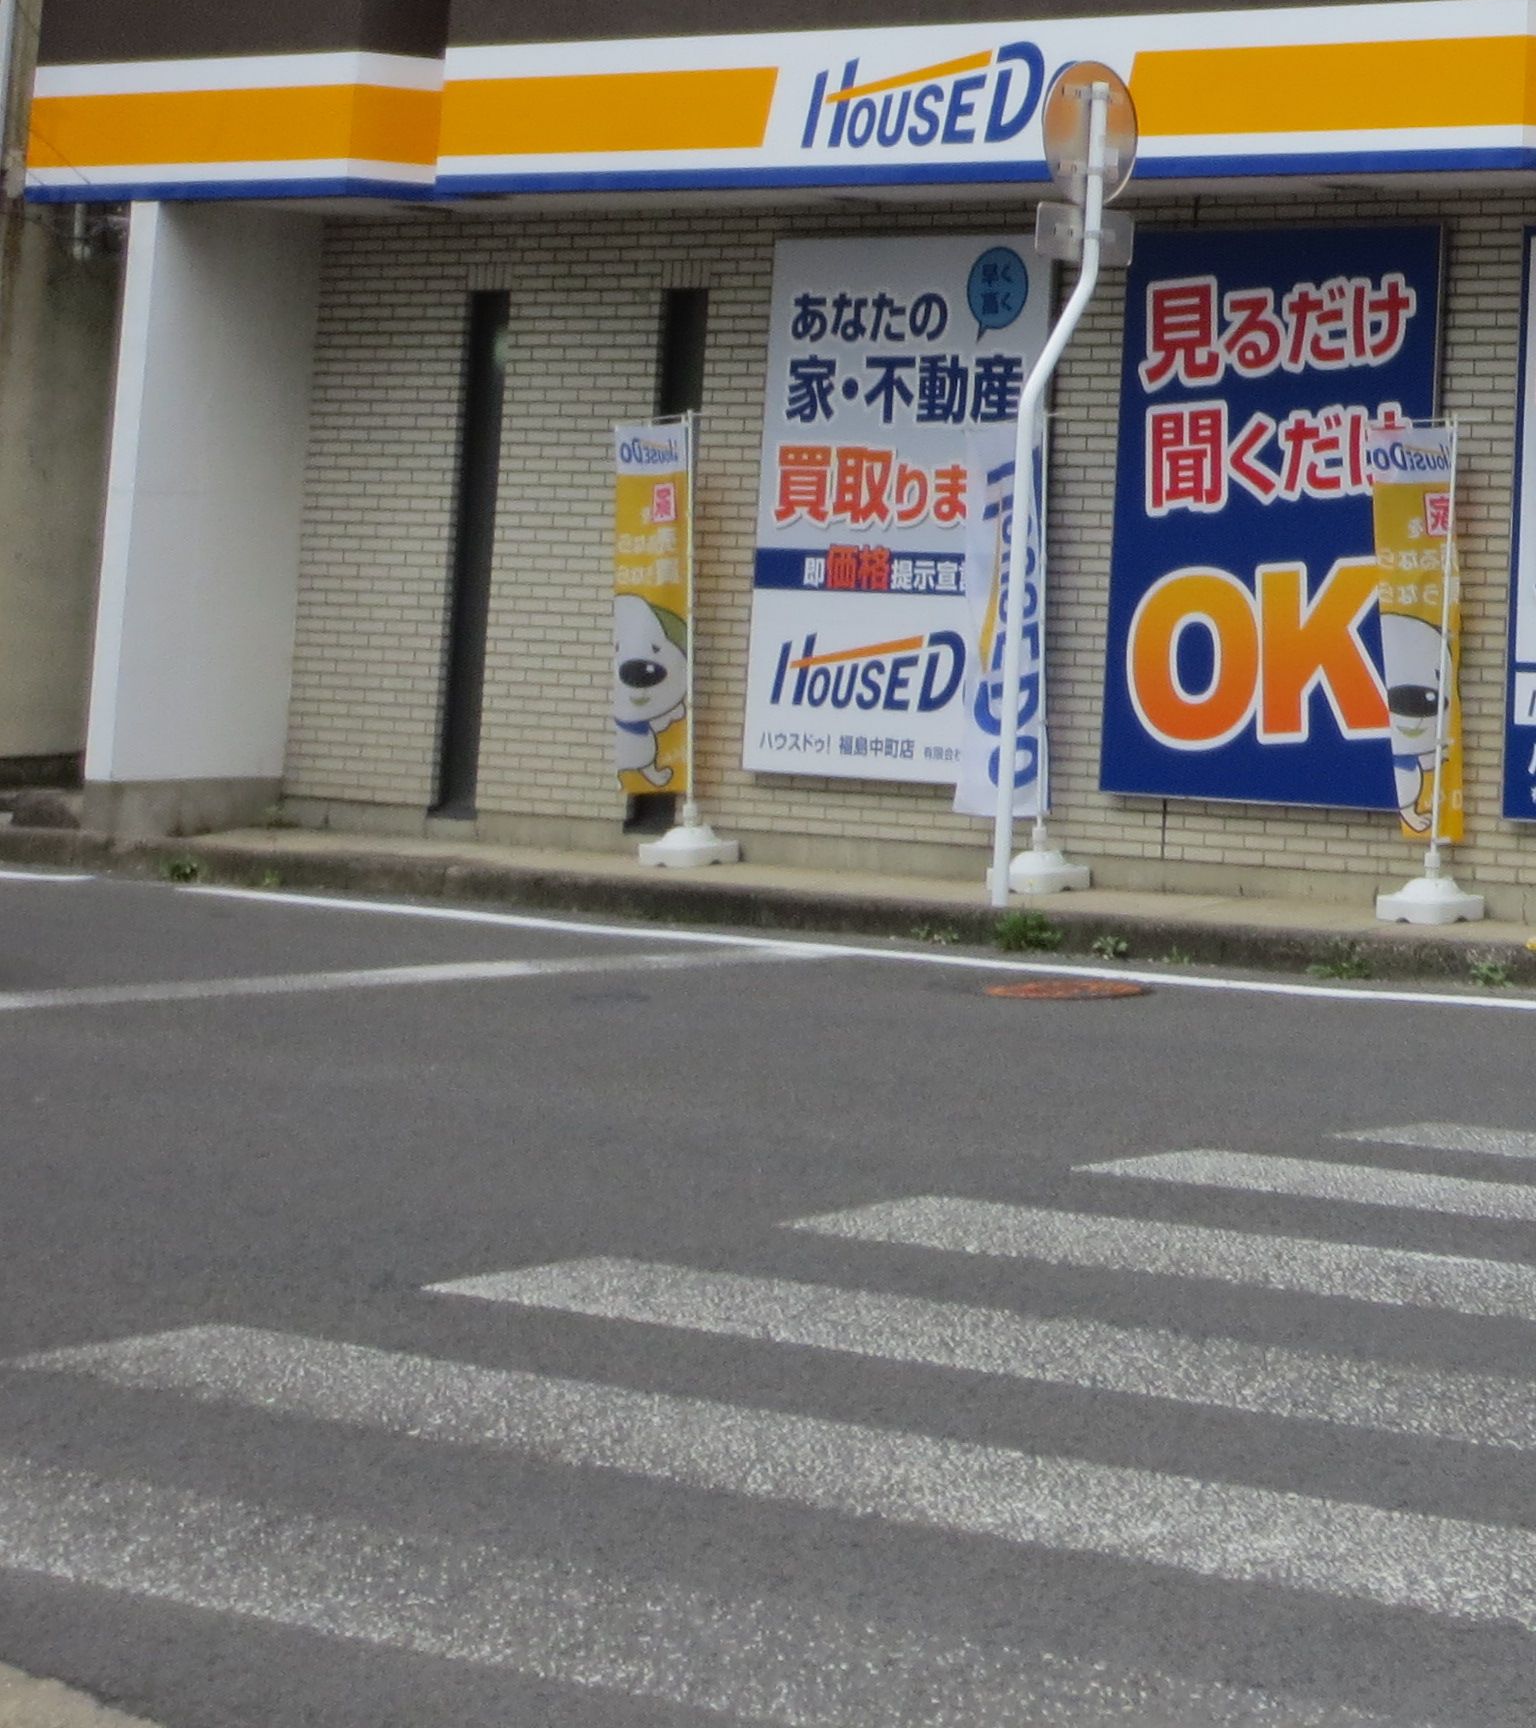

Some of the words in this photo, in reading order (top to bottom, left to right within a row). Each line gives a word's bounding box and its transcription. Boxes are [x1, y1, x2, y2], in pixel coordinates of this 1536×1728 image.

[800, 40, 1076, 149] HOUSED
[790, 292, 948, 343] あなたの
[1144, 280, 1410, 384] 見るだけ
[785, 353, 1024, 426] 家・不動産
[769, 628, 966, 713] HOUSED
[1132, 563, 1391, 742] OK
[839, 735, 915, 760] 福島中町店
